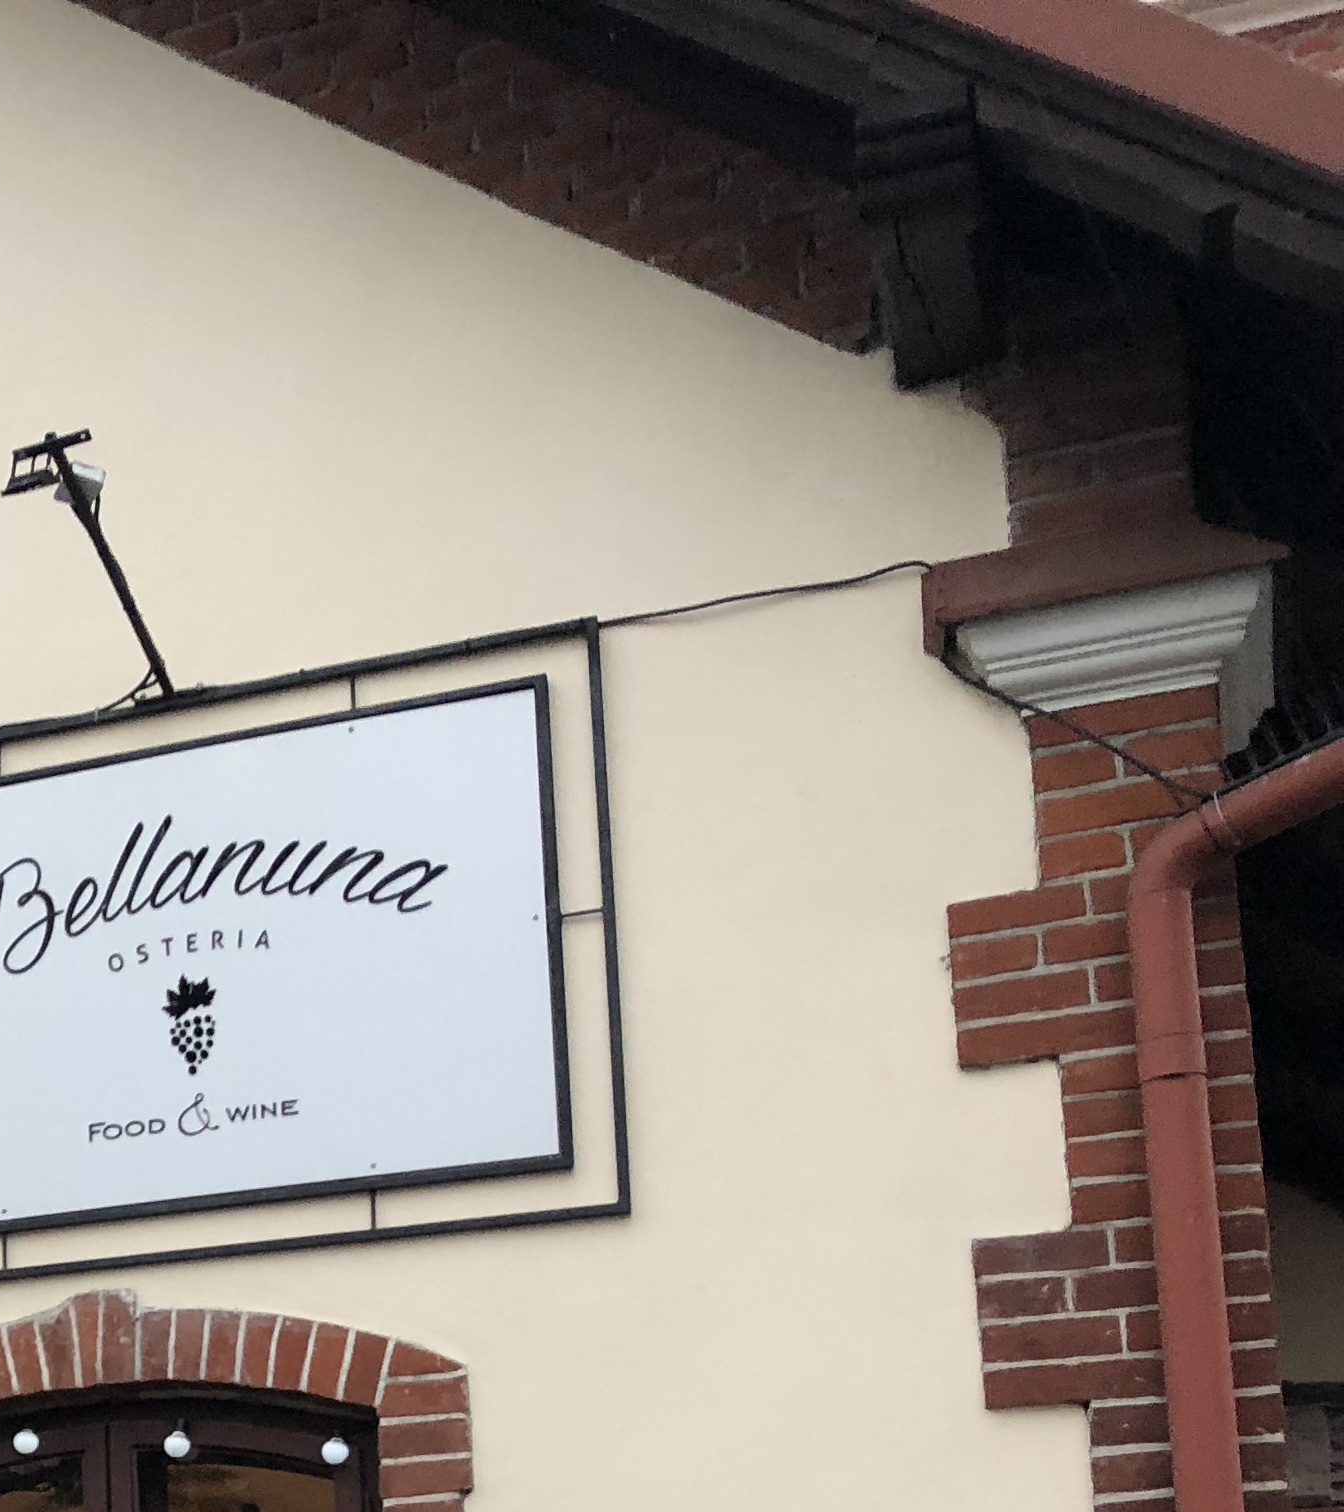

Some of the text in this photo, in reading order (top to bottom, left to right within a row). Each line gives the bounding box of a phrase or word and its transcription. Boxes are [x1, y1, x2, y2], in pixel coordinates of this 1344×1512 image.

[108, 929, 271, 973] OSTERIA
[88, 1092, 300, 1143] FOOD & WINE
